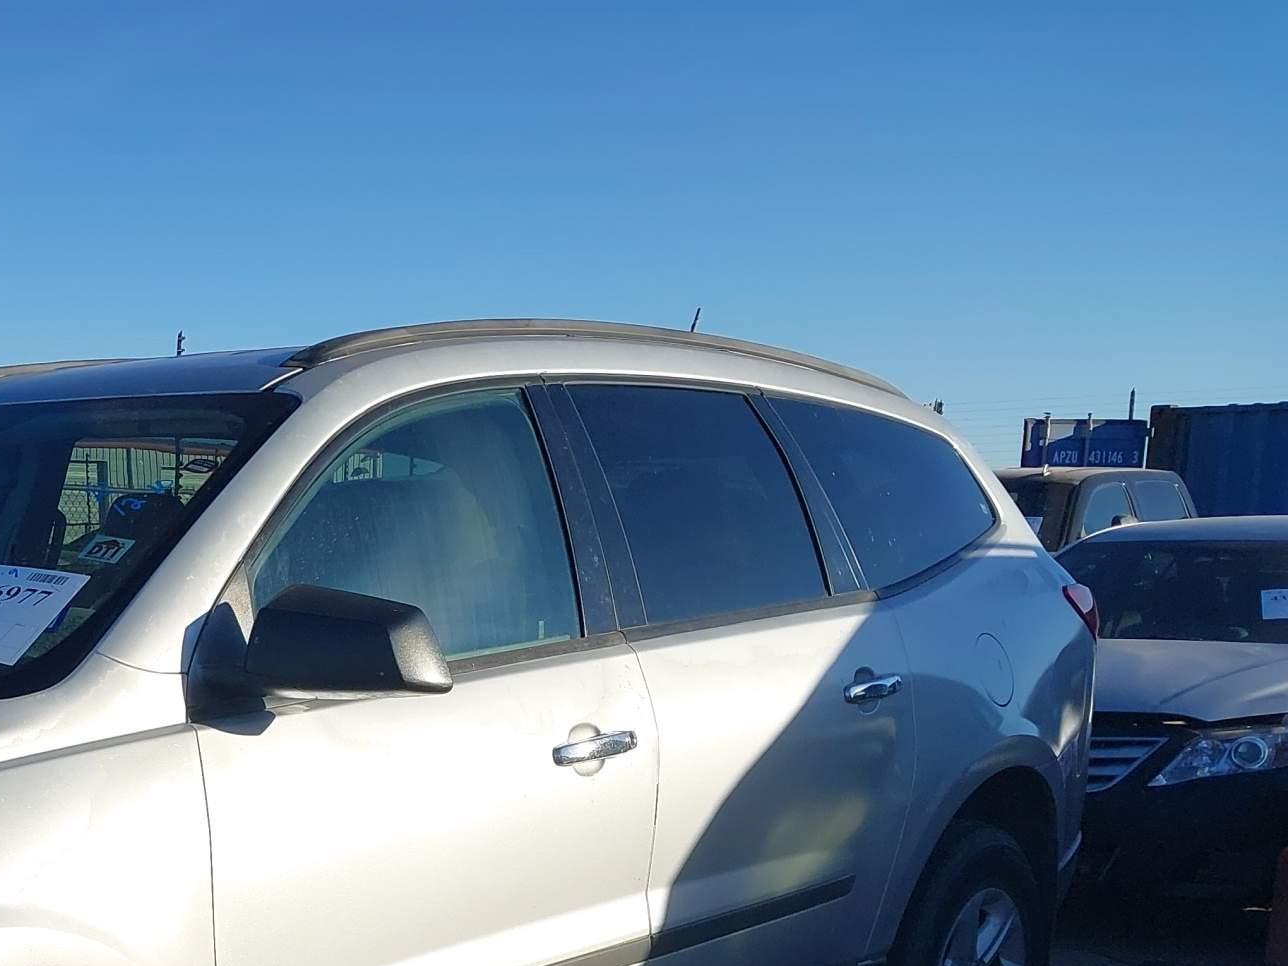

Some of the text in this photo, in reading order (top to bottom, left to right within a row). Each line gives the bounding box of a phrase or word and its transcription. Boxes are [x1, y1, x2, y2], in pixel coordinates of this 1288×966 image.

[1052, 451, 1139, 464] APZU 431146 3
